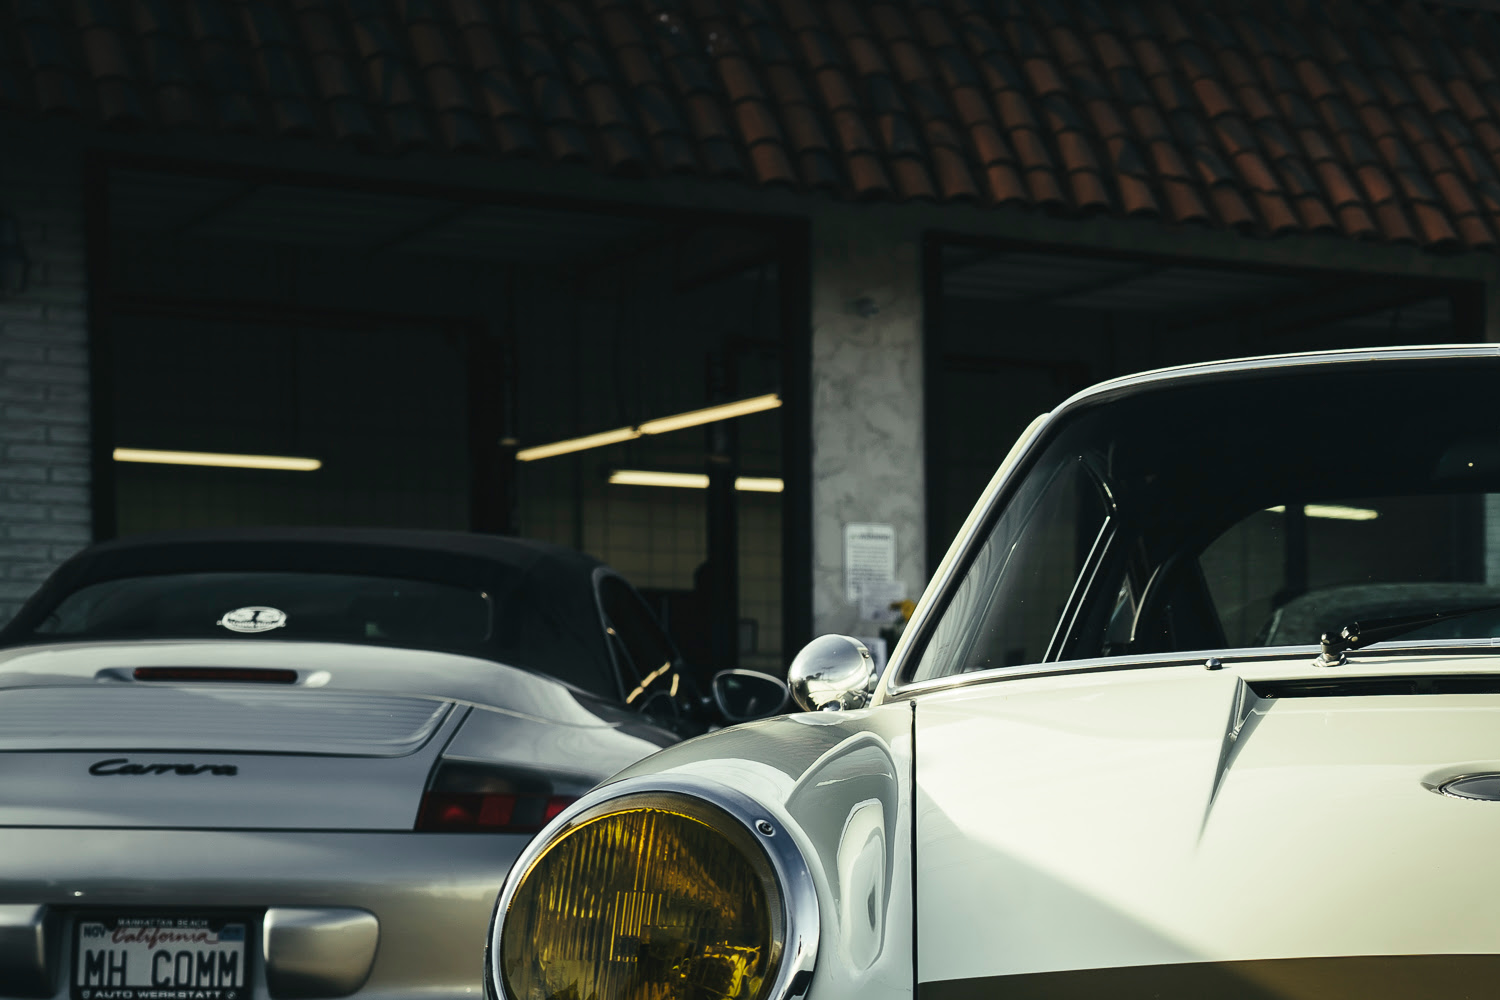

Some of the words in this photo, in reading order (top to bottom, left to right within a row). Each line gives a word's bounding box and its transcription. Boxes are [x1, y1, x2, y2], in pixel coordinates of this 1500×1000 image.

[89, 758, 238, 776] Carrera
[112, 927, 220, 949] California
[84, 950, 127, 986] MH
[151, 950, 238, 986] COMM
[95, 990, 133, 999] AUTO
[137, 990, 221, 999] WERKSTATT
